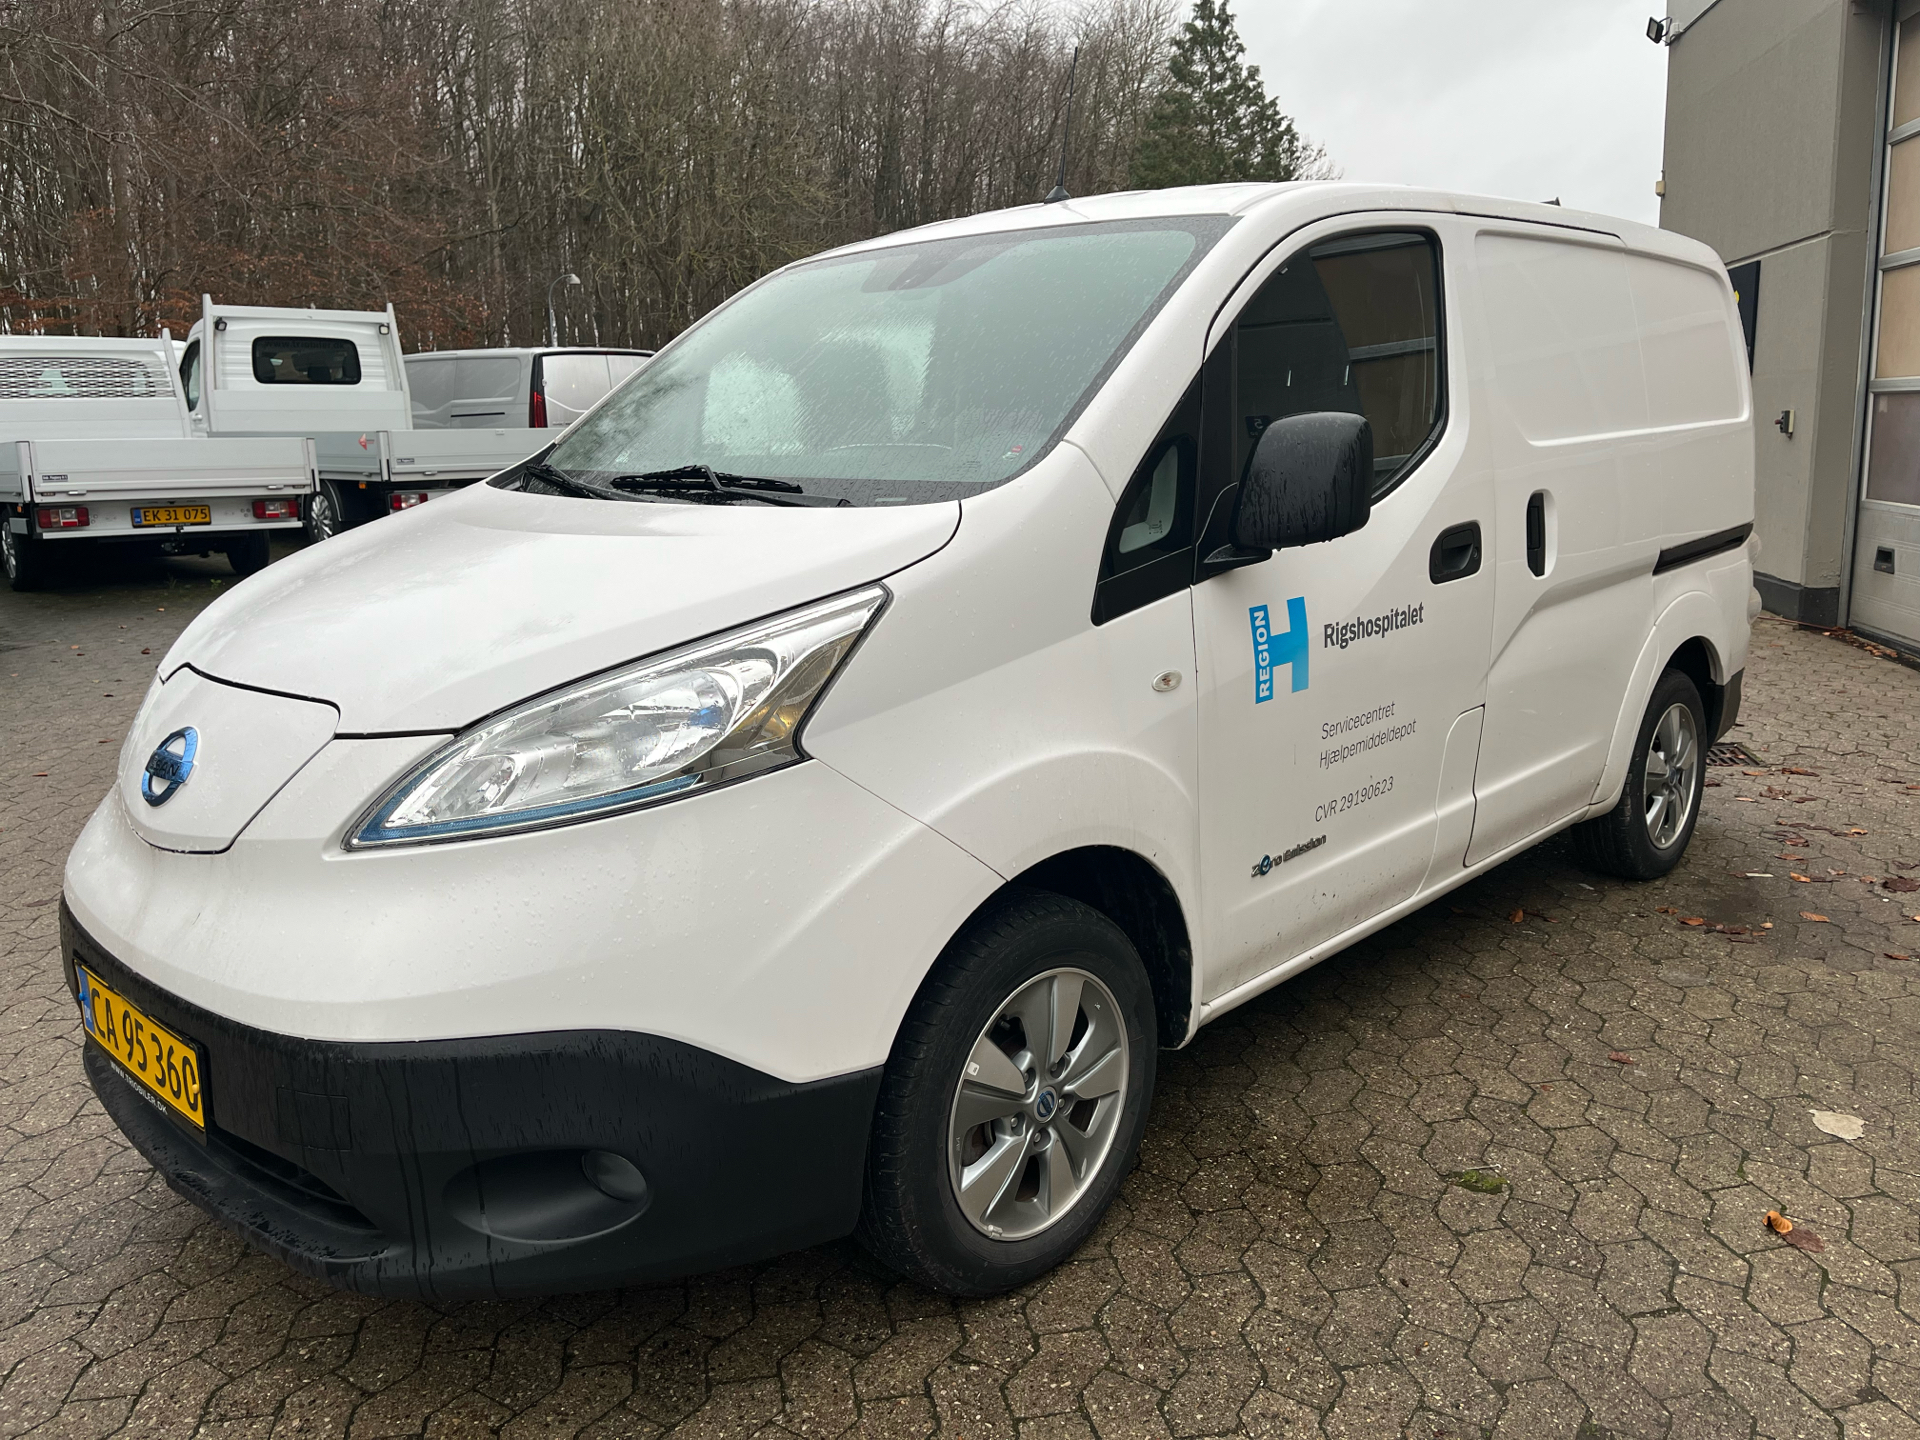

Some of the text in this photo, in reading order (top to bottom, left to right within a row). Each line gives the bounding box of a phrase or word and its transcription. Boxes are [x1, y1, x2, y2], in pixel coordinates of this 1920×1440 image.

[143, 509, 161, 522] EK
[164, 508, 179, 521] 31
[183, 507, 208, 520] 075
[1323, 602, 1425, 649] Rigshospitalet
[1254, 610, 1271, 698] REGION
[1319, 718, 1417, 770] Hjælpemiddeldepot
[1321, 701, 1396, 740] Servicecentret
[1315, 776, 1394, 823] CVR 29190623
[91, 987, 199, 1112] CA 95 360
